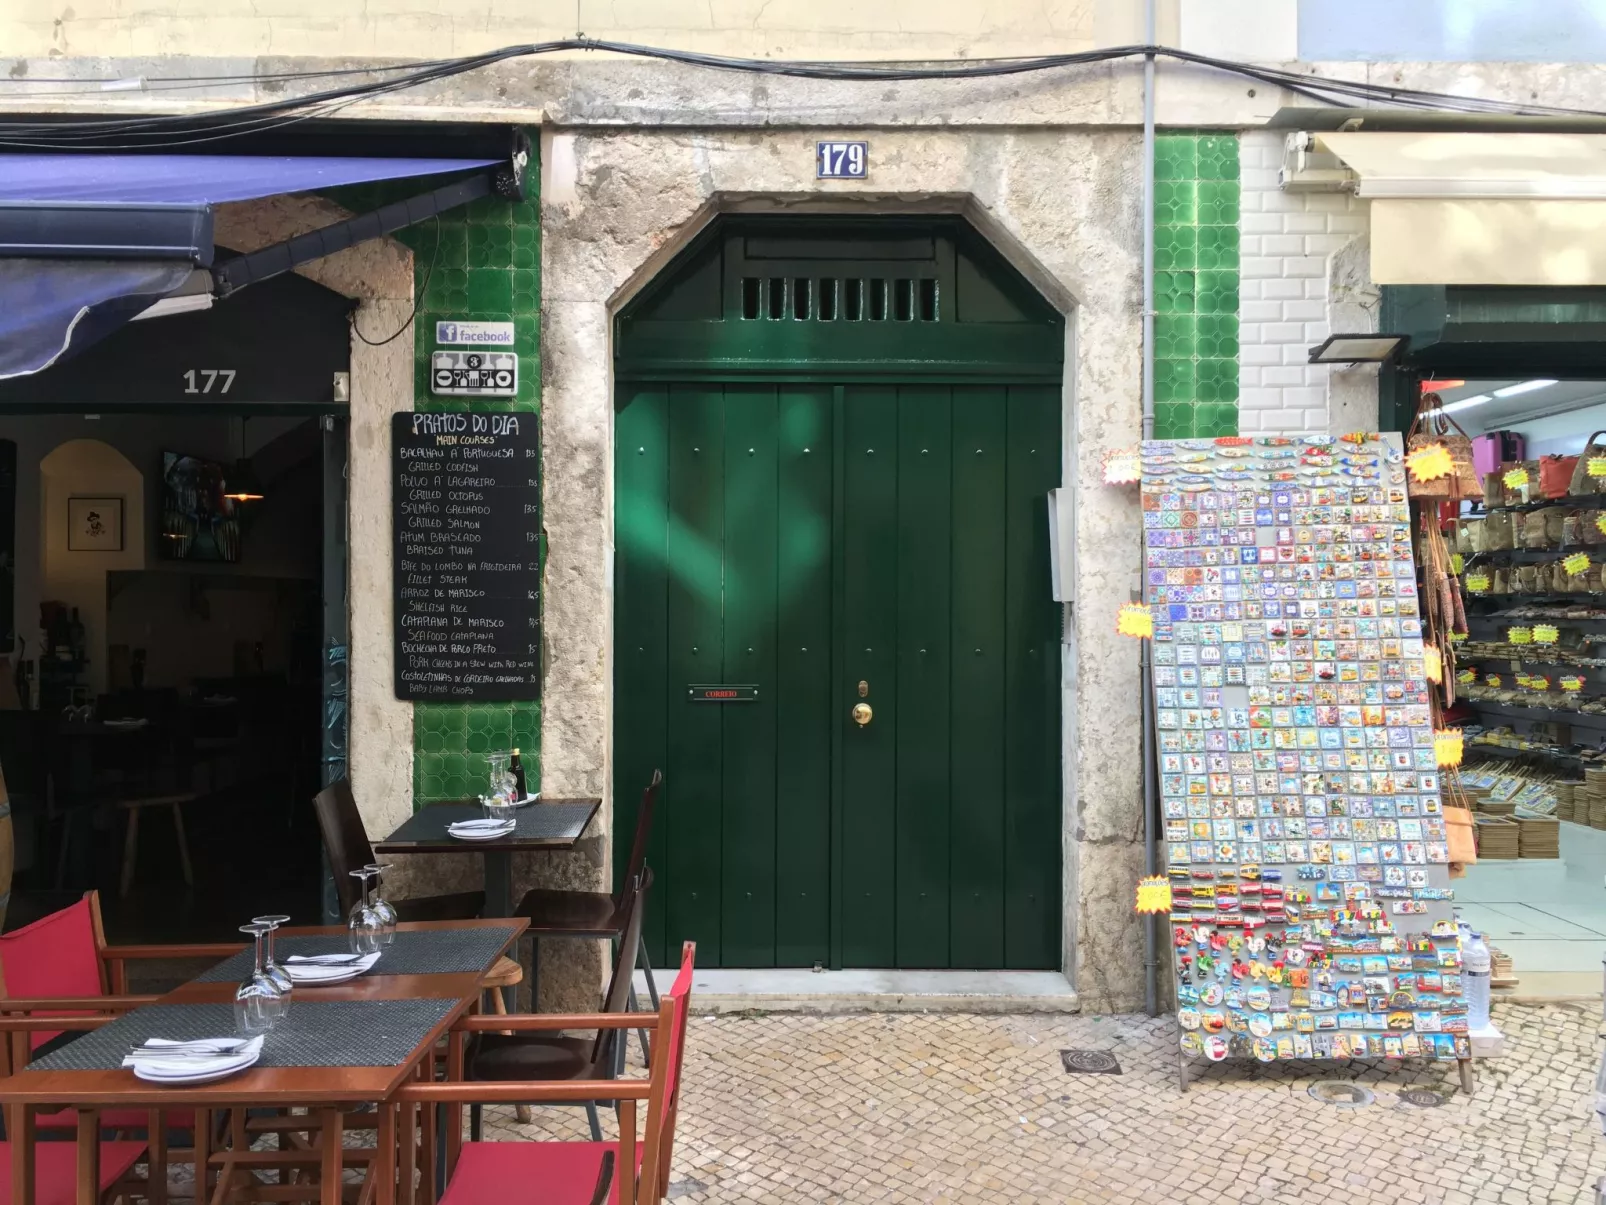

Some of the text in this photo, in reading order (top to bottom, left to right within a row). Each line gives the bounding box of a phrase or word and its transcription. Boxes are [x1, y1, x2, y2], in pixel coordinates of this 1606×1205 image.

[822, 144, 863, 175] 179
[460, 330, 510, 341] facebook
[183, 369, 237, 394] 177
[413, 413, 519, 435] PRATOS DO DIA
[400, 448, 444, 458] BACALHAU
[464, 449, 513, 458] PORTUGUESA
[409, 462, 478, 471] GRILLED CODFISH
[400, 475, 428, 486] POLVO
[448, 477, 495, 486] LAGAREIRO
[410, 490, 483, 500] GRILLED OCTOPUS
[446, 505, 490, 514] GRELHADO
[409, 517, 480, 529] GRILLED SALMON
[400, 532, 425, 543] ATUM
[407, 545, 473, 556] BRAISED TUNA
[401, 560, 417, 571] BIFE
[435, 561, 463, 570] LOMBO
[480, 561, 521, 571] FRIGIDEIRA
[408, 574, 467, 584] FILLET STEAK
[401, 587, 429, 598] ARROZ
[435, 589, 445, 598] DE
[449, 589, 485, 597] MARISCO
[408, 600, 467, 612] SHELFISH RICE
[401, 615, 448, 627] CATAPLANA
[454, 617, 463, 625] DE
[469, 618, 504, 628] MARISCO
[408, 629, 493, 640] SEAFOOD CATAPLANA
[439, 645, 448, 653] DE
[451, 644, 470, 653] PORCO
[473, 644, 496, 653] PRETO
[410, 655, 428, 668] PORK
[470, 658, 485, 668] STEW
[506, 659, 516, 668] RED
[429, 684, 447, 694] LAMB
[452, 686, 473, 695] CHOPS
